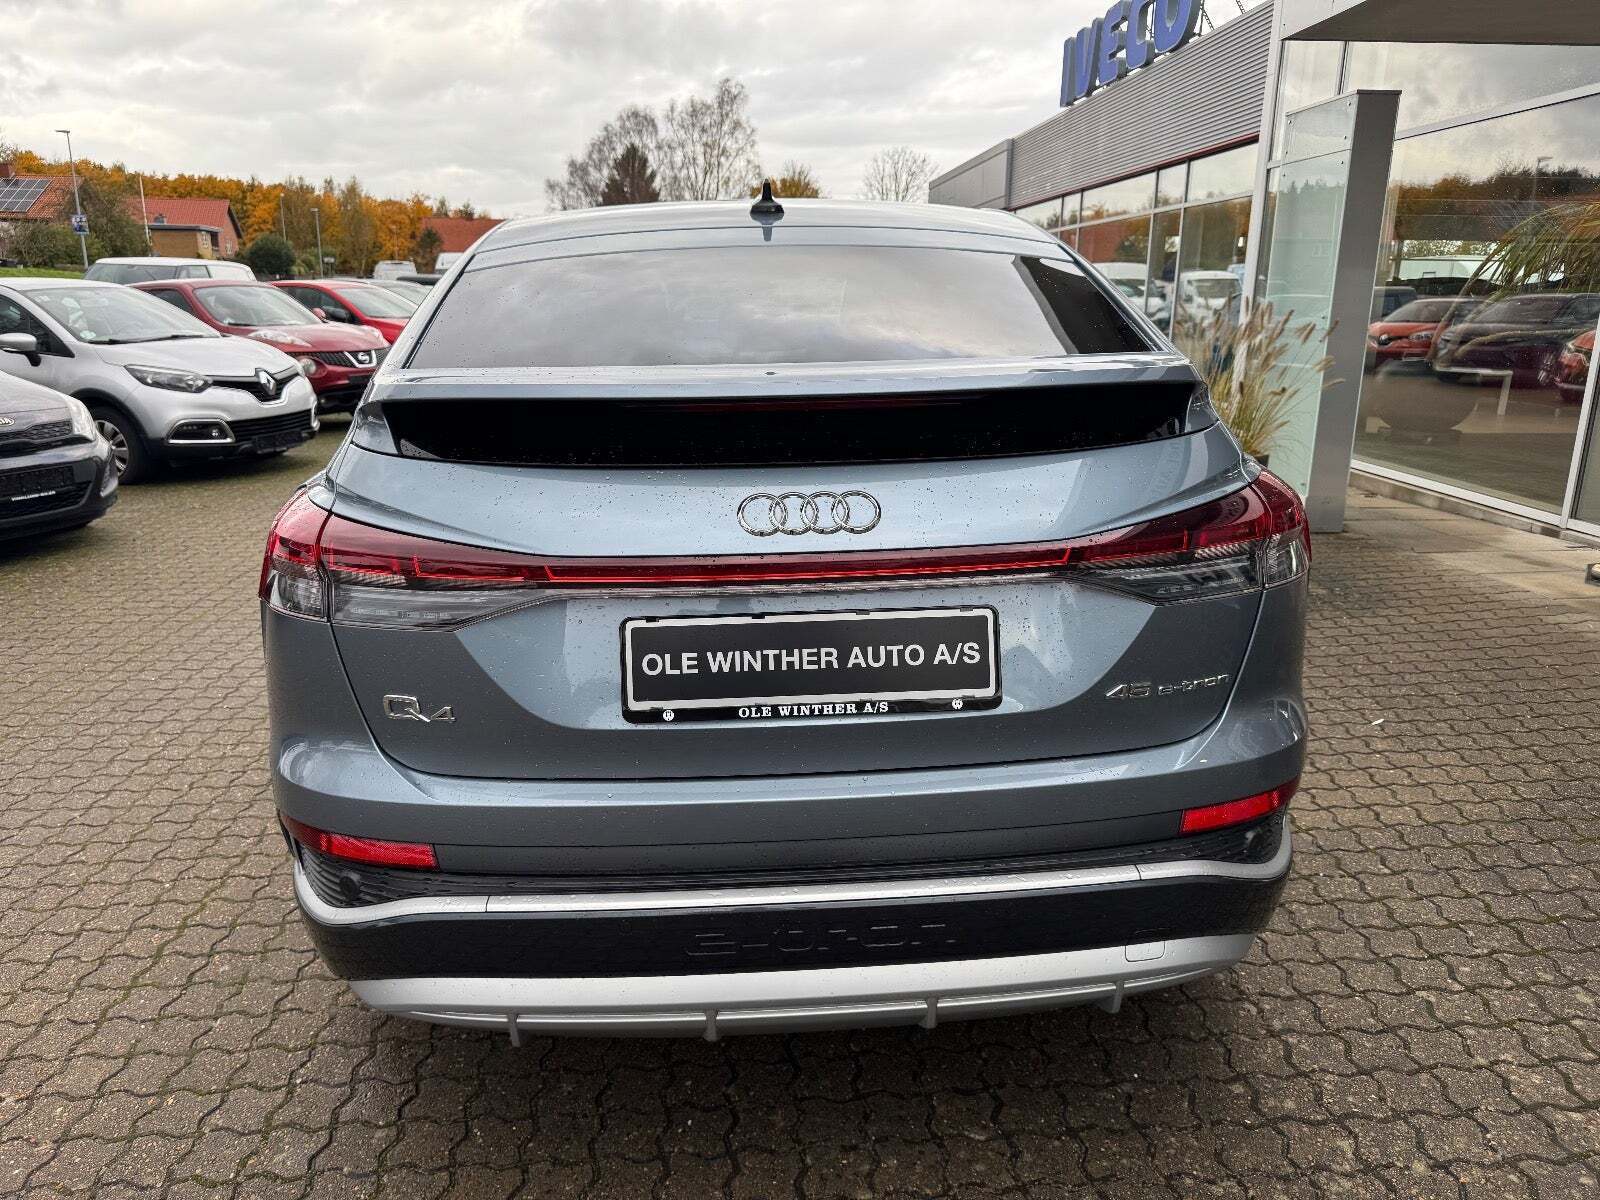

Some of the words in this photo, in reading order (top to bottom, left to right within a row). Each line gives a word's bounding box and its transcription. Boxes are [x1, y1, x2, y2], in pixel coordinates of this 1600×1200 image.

[642, 653, 698, 676] OLE
[707, 648, 838, 673] WINTHER
[847, 645, 925, 669] AUTO
[933, 642, 981, 665] A/S
[1105, 682, 1152, 699] 45
[1157, 674, 1229, 695] e-tron
[383, 694, 456, 722] Q4
[738, 706, 772, 718] OLE
[779, 703, 858, 717] WINTHER
[863, 702, 889, 713] A/S
